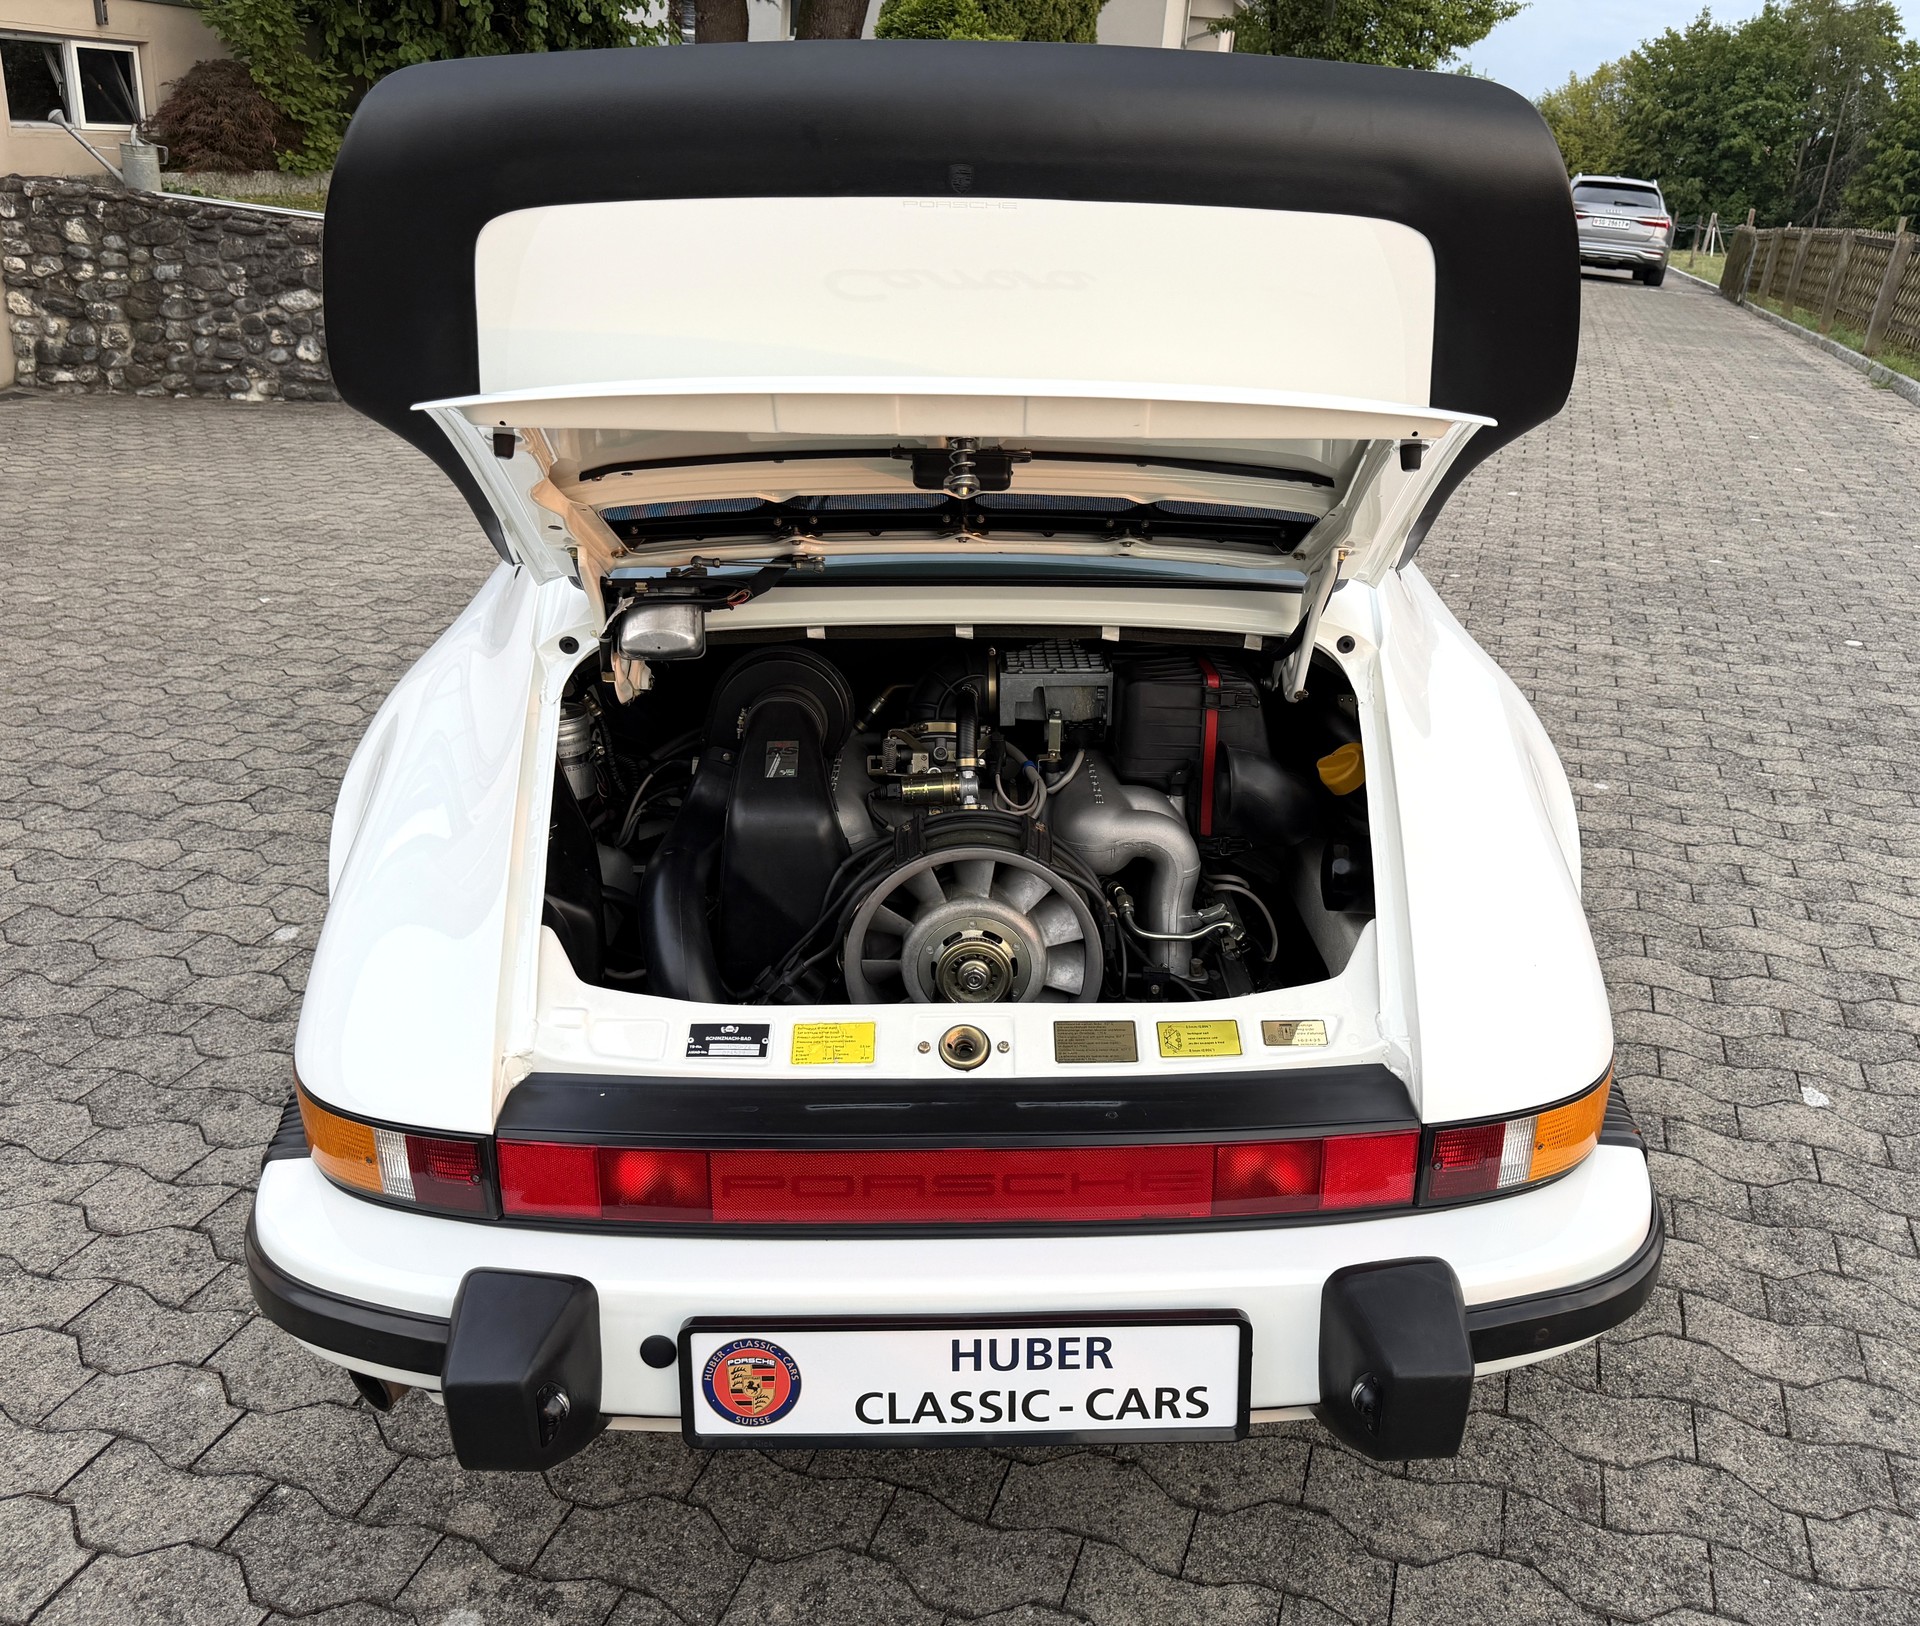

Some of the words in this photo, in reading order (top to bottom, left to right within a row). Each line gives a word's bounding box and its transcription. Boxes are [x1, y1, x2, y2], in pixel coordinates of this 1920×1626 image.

[902, 200, 1018, 210] PORSCHE
[721, 1171, 1201, 1198] PORSCHE
[704, 1351, 725, 1381] HUBER
[732, 1340, 777, 1353] CLASSIC
[783, 1356, 800, 1381] CARS
[727, 1358, 775, 1366] PORSCHE
[951, 1336, 1114, 1372] HUBER
[734, 1415, 772, 1426] SUISSE
